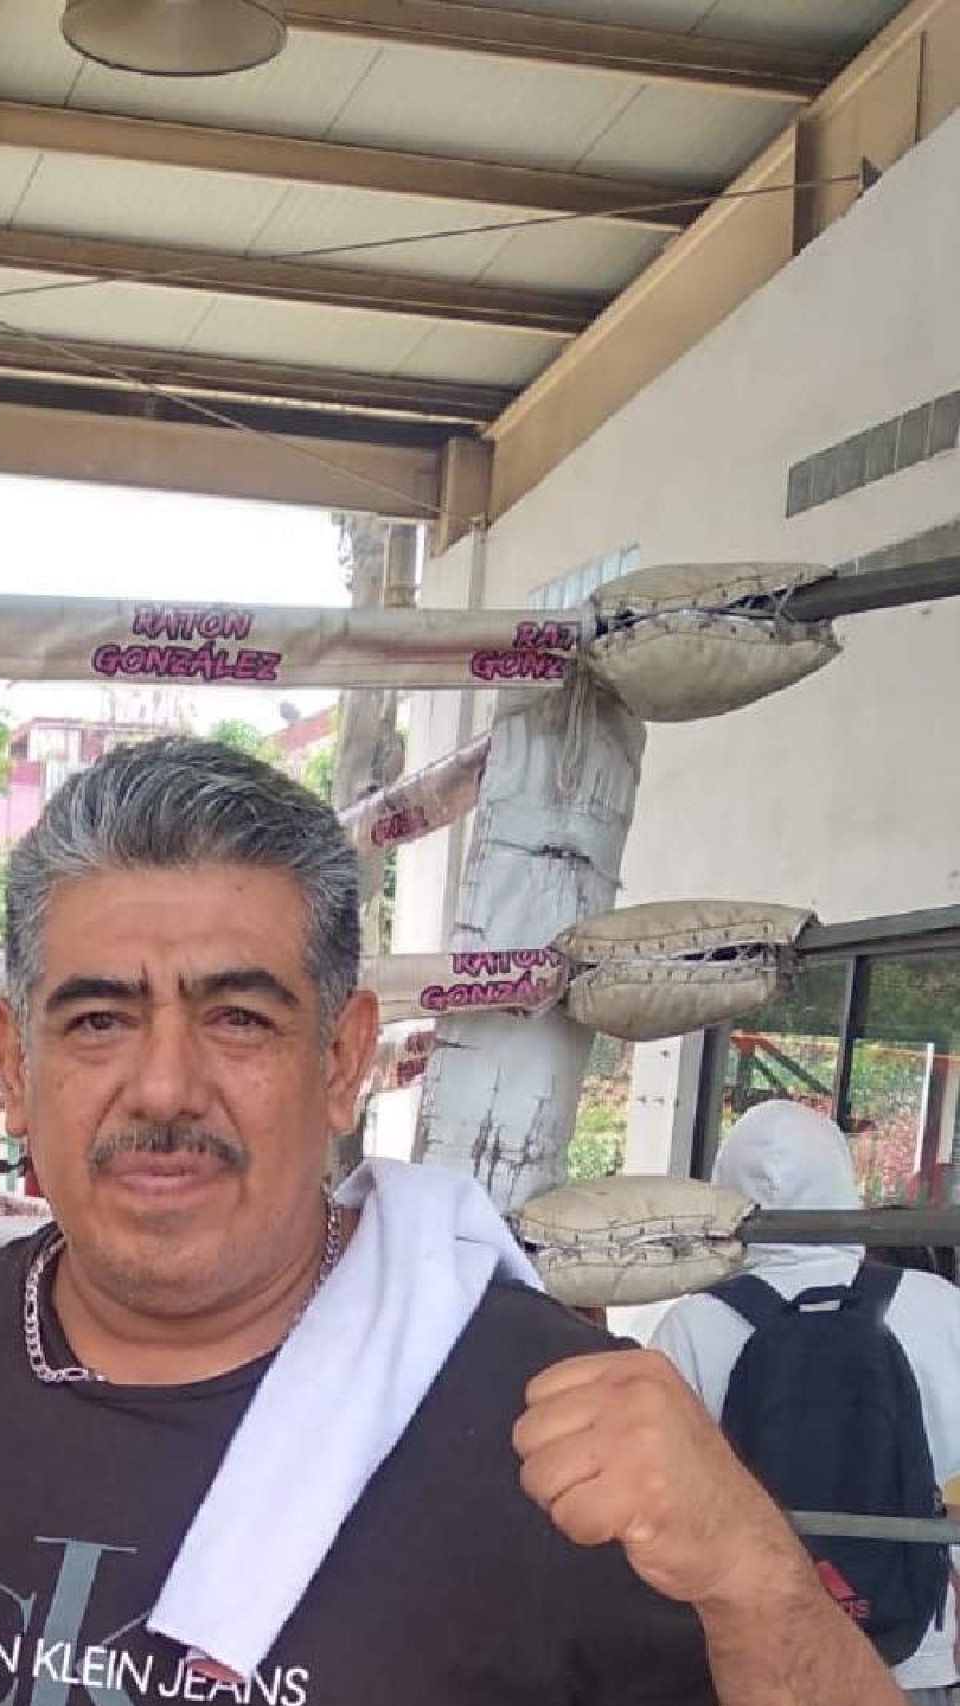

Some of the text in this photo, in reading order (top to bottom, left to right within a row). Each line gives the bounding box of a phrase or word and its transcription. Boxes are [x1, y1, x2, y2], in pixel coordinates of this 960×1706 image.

[512, 621, 581, 651] RAT
[93, 640, 282, 683] GONZÁLEZ
[31, 1637, 155, 1696] KLEIN
